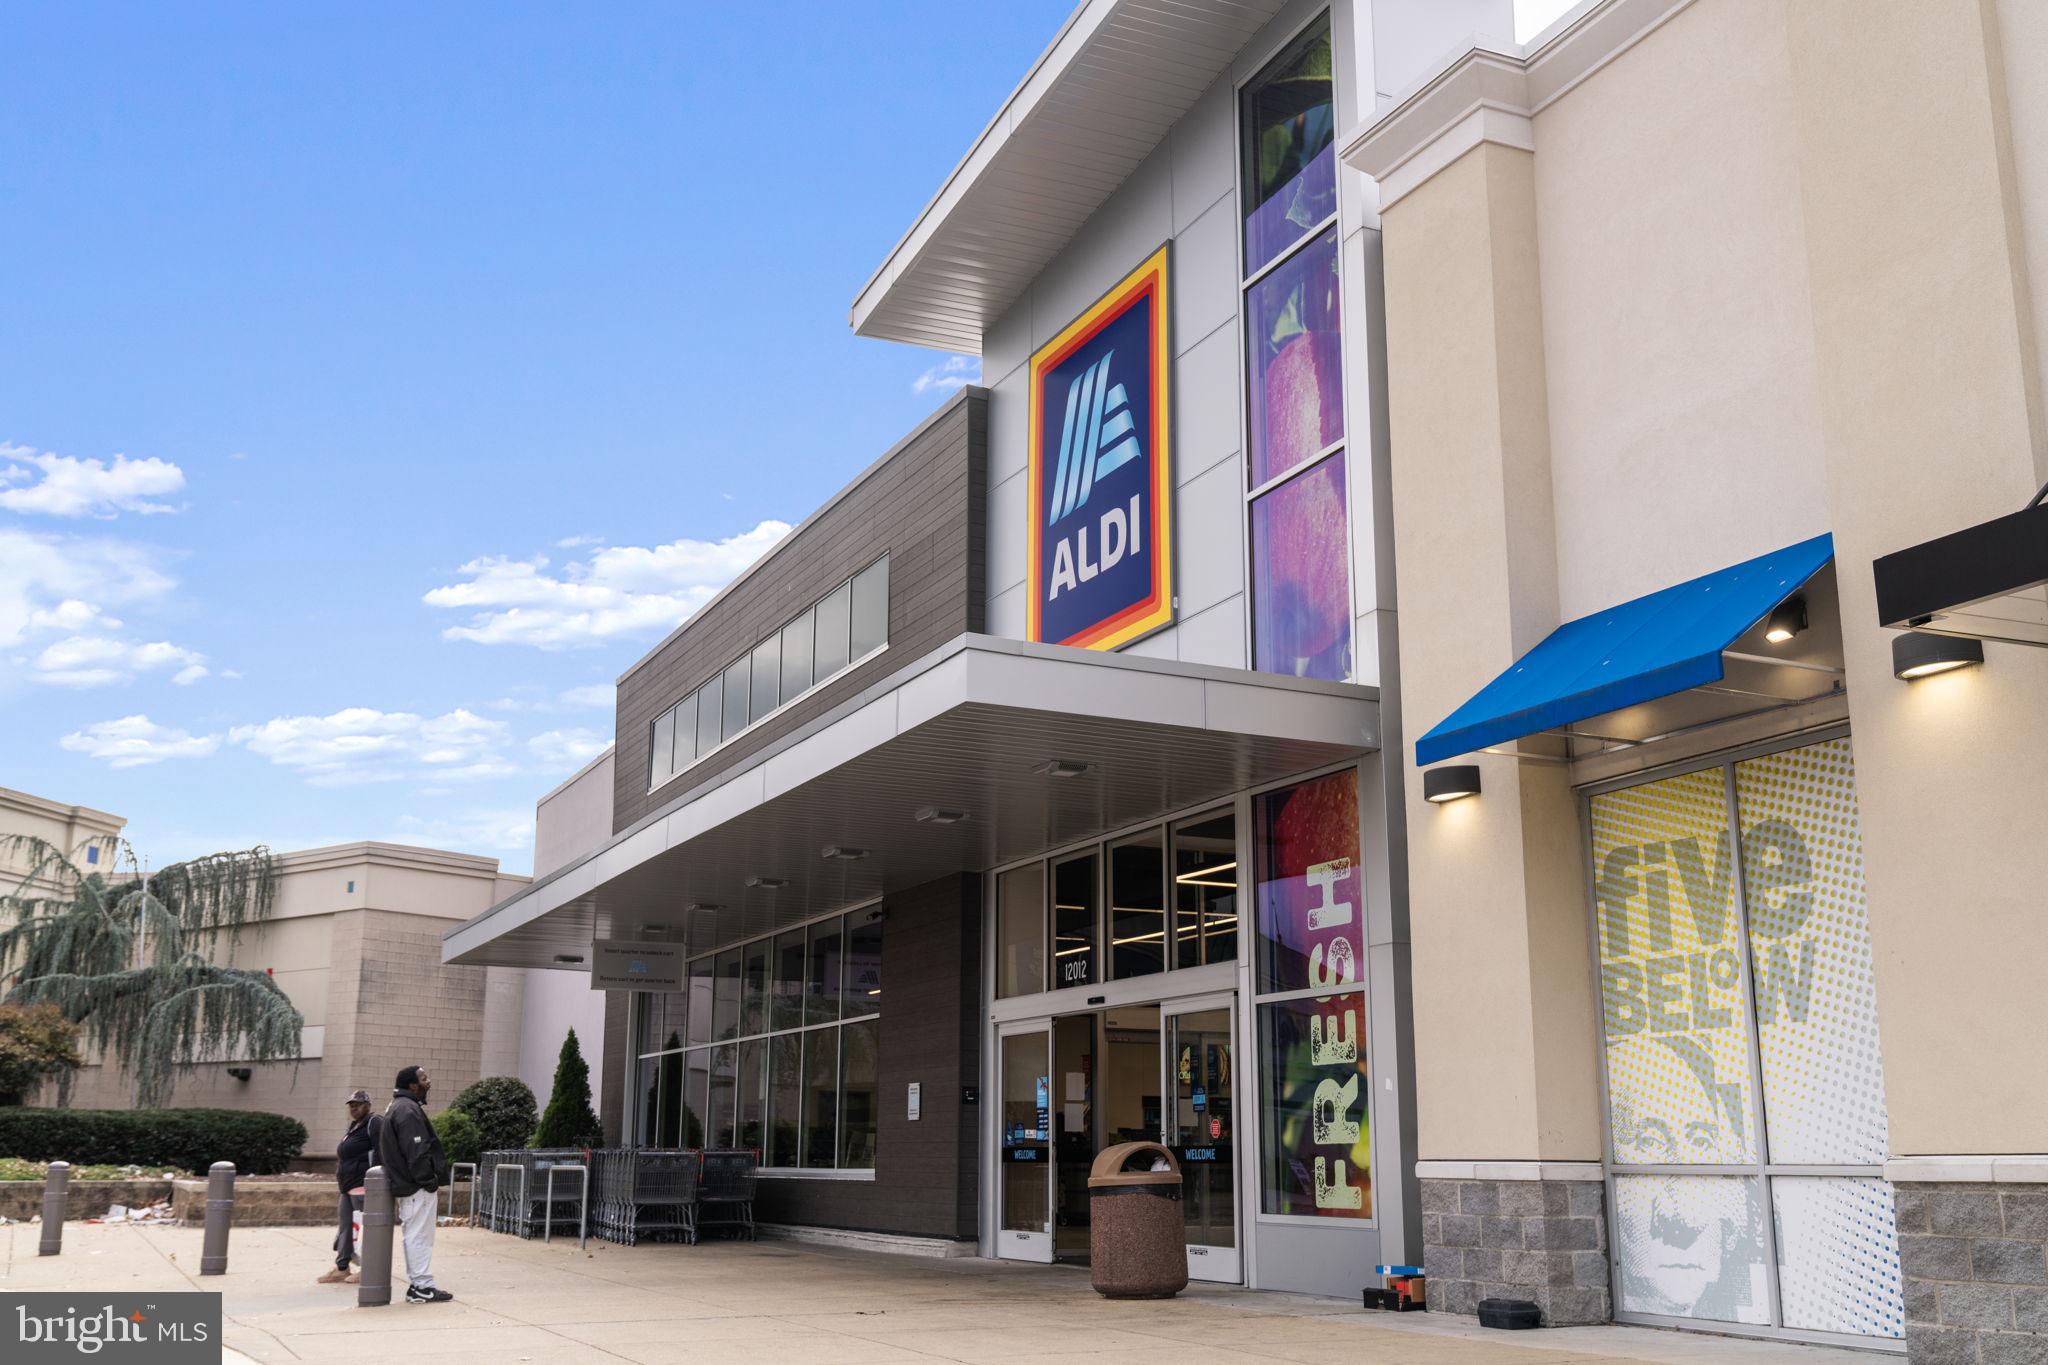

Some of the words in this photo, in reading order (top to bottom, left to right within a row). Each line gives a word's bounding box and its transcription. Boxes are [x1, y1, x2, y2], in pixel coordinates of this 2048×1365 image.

[1049, 493, 1141, 602] ALDI
[1065, 960, 1087, 981] 12012
[1602, 940, 1816, 1036] BELOW
[1306, 856, 1362, 1210] FRESH
[1014, 1149, 1037, 1160] WELCOME
[1185, 1148, 1216, 1160] WELCOME
